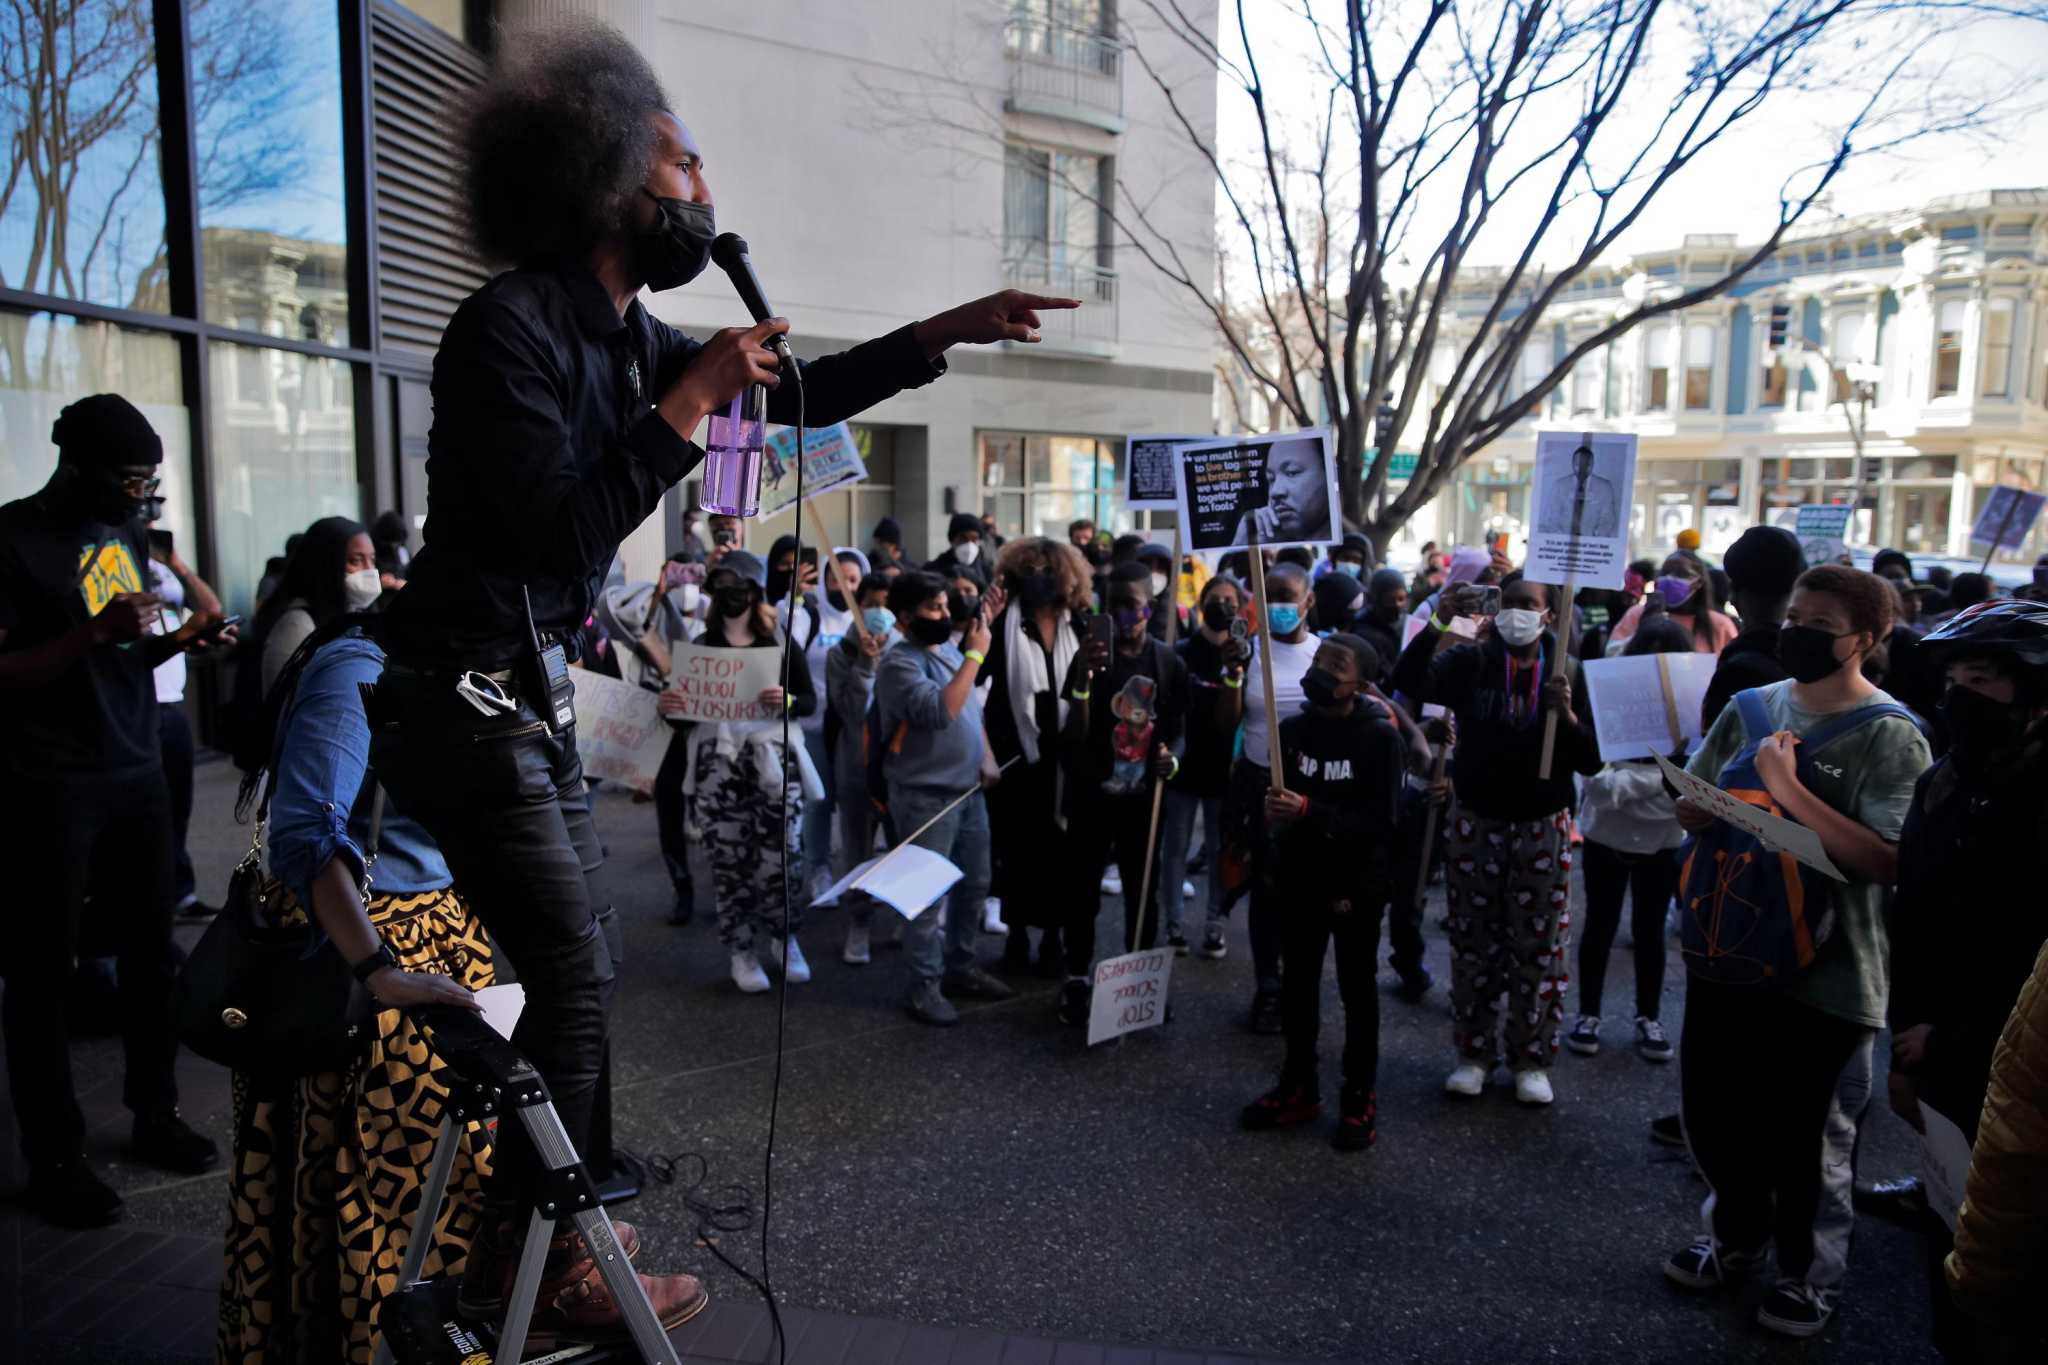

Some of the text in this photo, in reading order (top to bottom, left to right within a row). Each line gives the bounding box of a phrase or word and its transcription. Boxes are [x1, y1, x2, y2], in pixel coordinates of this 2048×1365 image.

[1209, 450, 1232, 461] must
[1234, 449, 1258, 459] lrn
[1194, 464, 1205, 473] to
[1224, 459, 1264, 471] togher
[1195, 475, 1207, 483] as
[1196, 485, 1211, 493] we
[1212, 481, 1229, 491] will
[1197, 492, 1237, 504] together
[1198, 505, 1210, 513] as
[688, 655, 744, 677] STOP
[678, 675, 736, 698] SCHOOL
[1112, 978, 1159, 1003] SCHOOL
[1118, 1001, 1155, 1028] STOP
[443, 1320, 474, 1355] GORILLA
